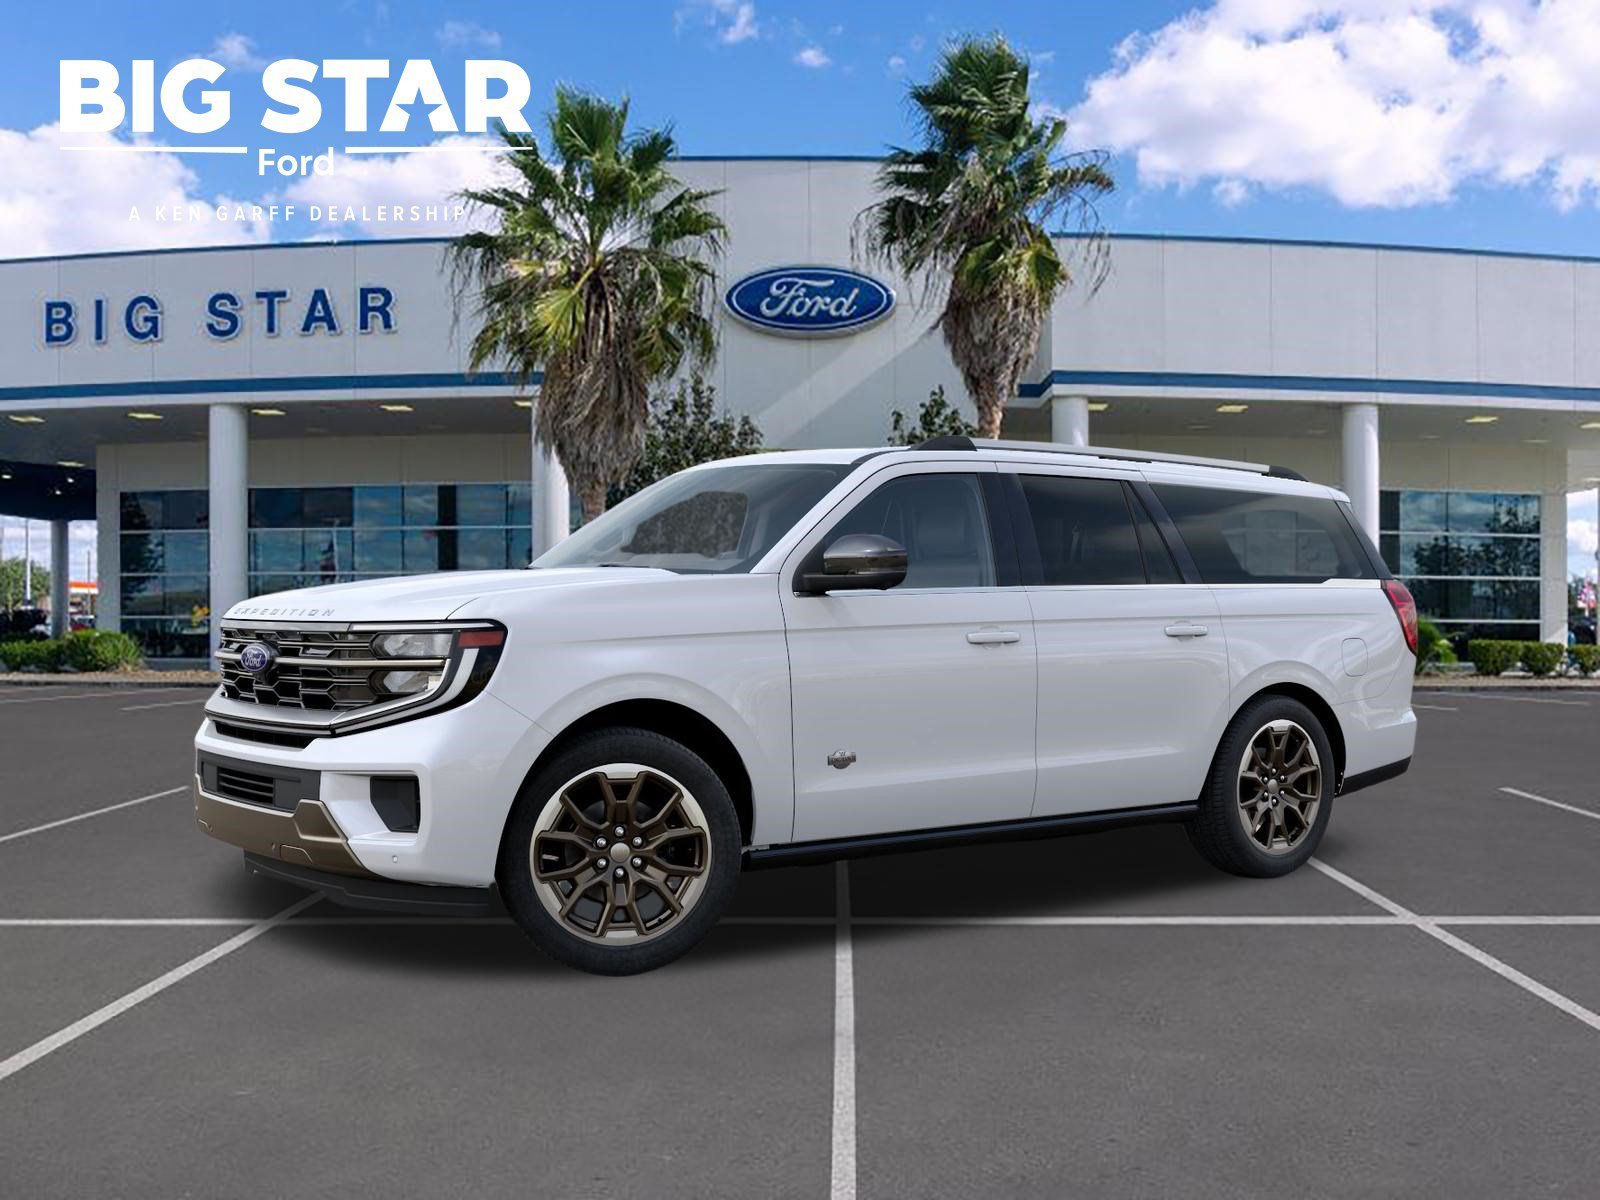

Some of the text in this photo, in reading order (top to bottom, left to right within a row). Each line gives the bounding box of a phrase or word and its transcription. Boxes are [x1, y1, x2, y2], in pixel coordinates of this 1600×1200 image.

[759, 277, 859, 318] Ford
[44, 285, 399, 346] BIG STAR
[233, 607, 335, 617] EXPEDITION
[244, 649, 263, 667] Ford
